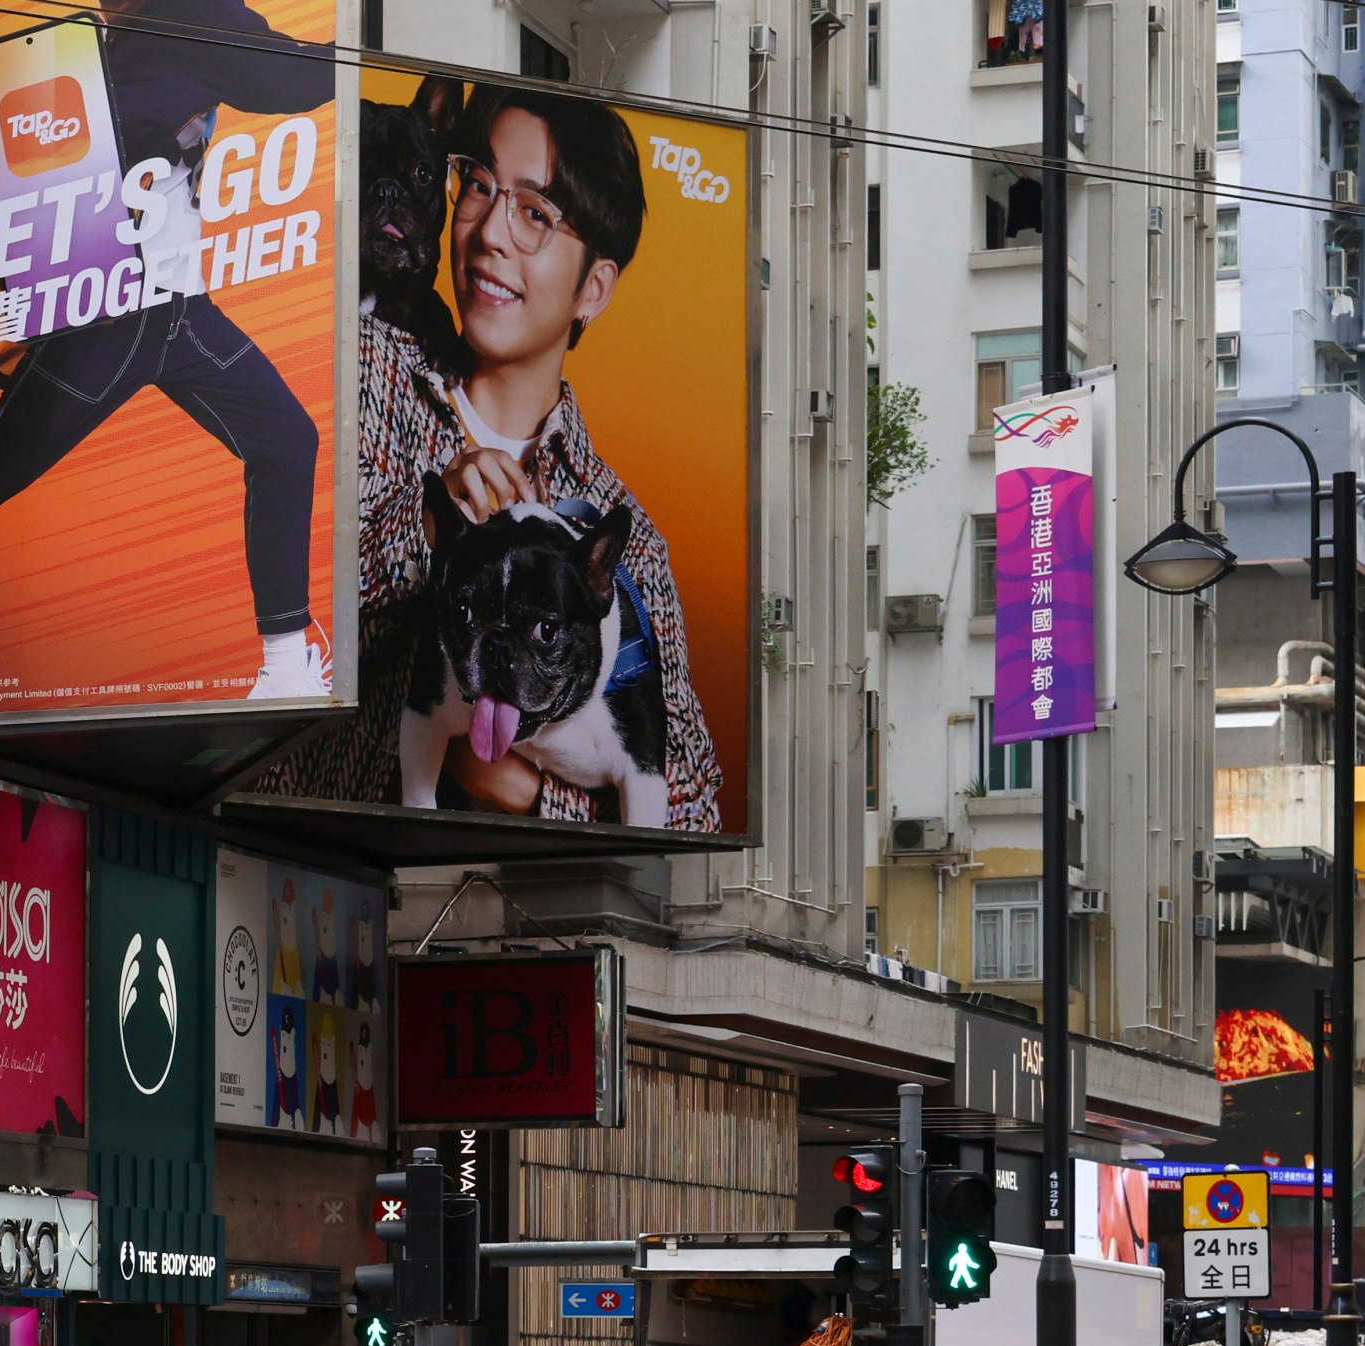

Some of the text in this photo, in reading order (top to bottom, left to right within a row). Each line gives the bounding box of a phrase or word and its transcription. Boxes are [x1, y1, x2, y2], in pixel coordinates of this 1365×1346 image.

[199, 116, 318, 223] GO
[1030, 484, 1054, 720] 香港亞洲國際都會
[24, 688, 52, 698] Limited
[10, 1049, 46, 1073] beautiful
[461, 1159, 476, 1196] WA
[996, 1169, 1018, 1191] HANEL
[1050, 1171, 1058, 1217] 49278
[1194, 1238, 1259, 1257] 24 hrs
[138, 1250, 216, 1278] THE BODY SHOP
[1200, 1265, 1252, 1290] 全日
